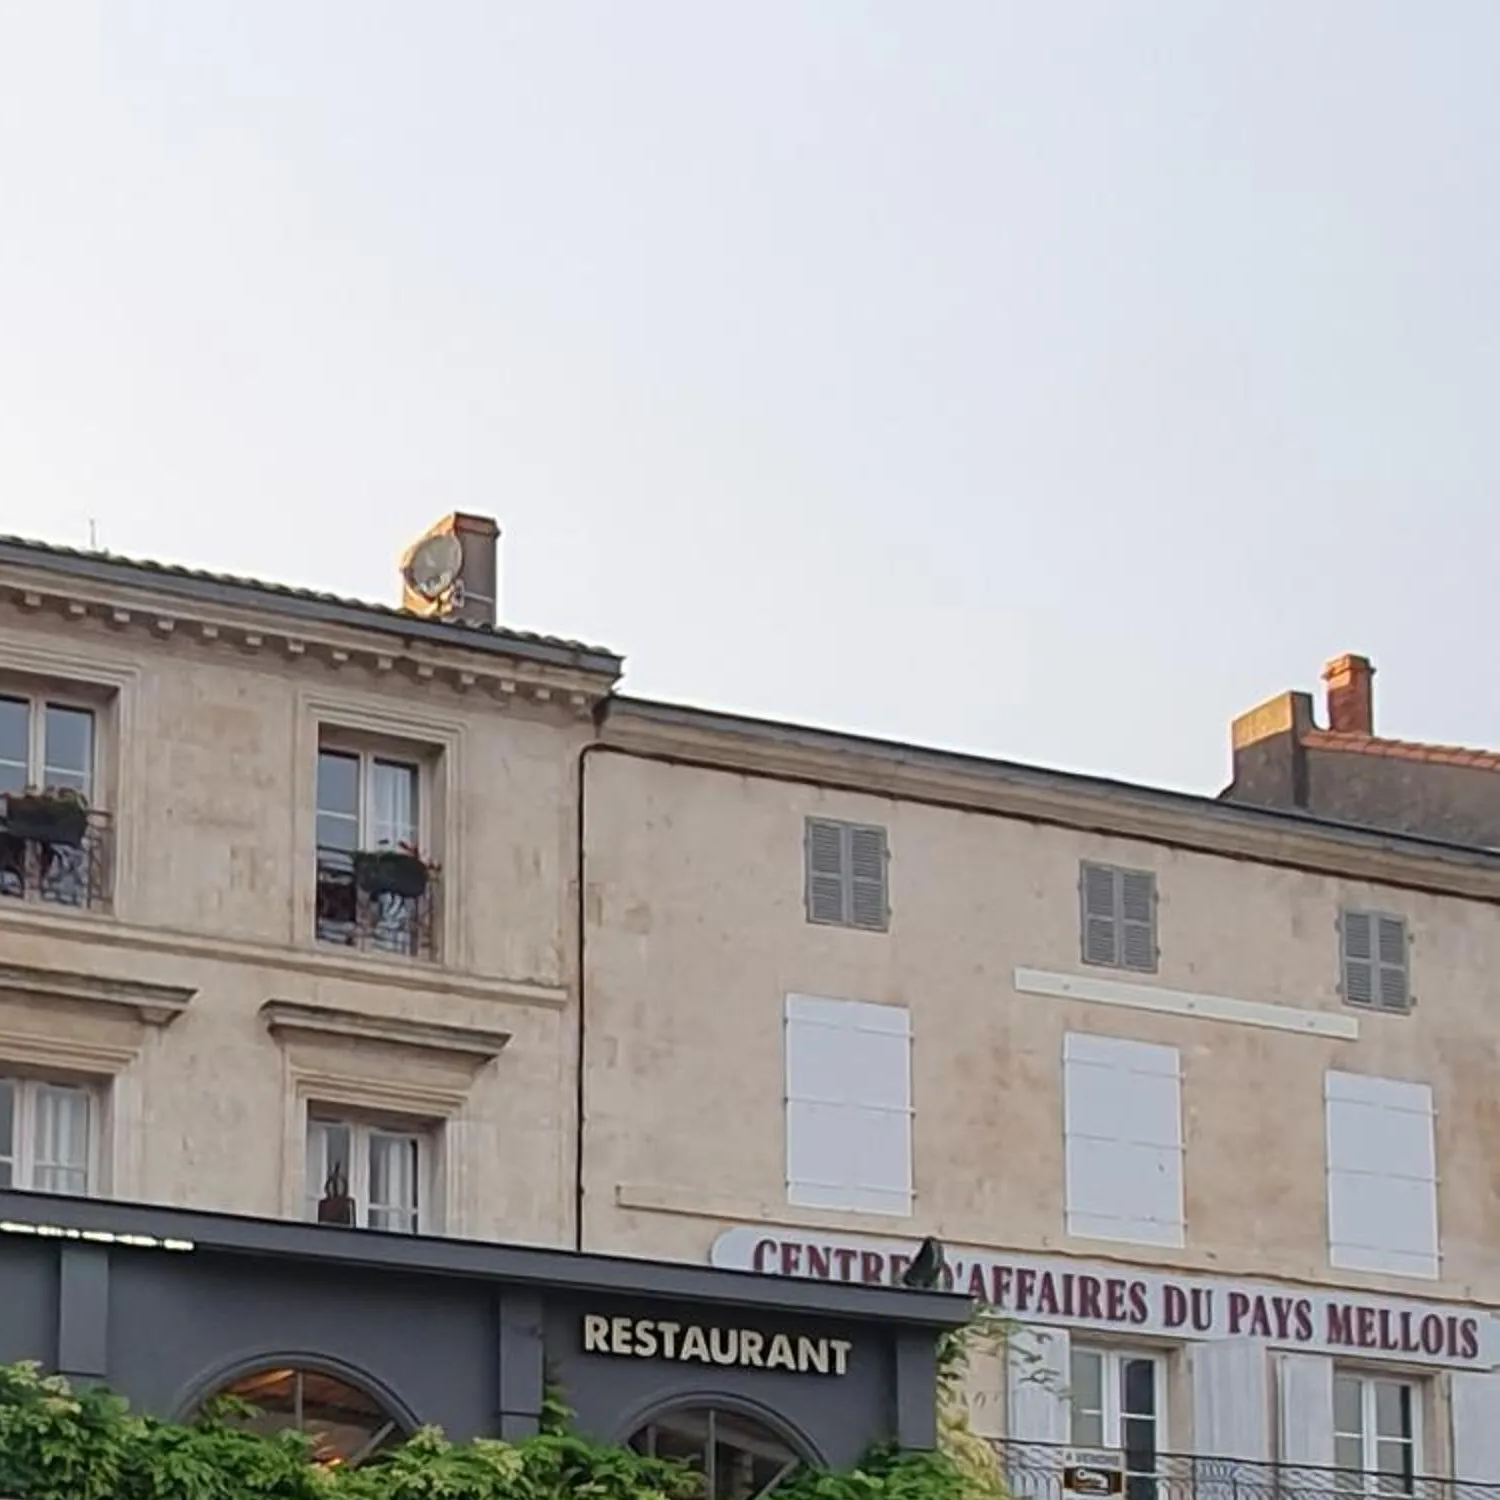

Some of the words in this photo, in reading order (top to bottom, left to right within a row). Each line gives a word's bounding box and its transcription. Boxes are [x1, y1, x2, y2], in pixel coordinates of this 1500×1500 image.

[583, 1313, 852, 1376] RESTAURANT
[753, 1238, 911, 1287] CENTRE
[1162, 1285, 1214, 1332] DU
[1227, 1291, 1314, 1342] PAYS
[1326, 1302, 1479, 1360] MELLOIS
